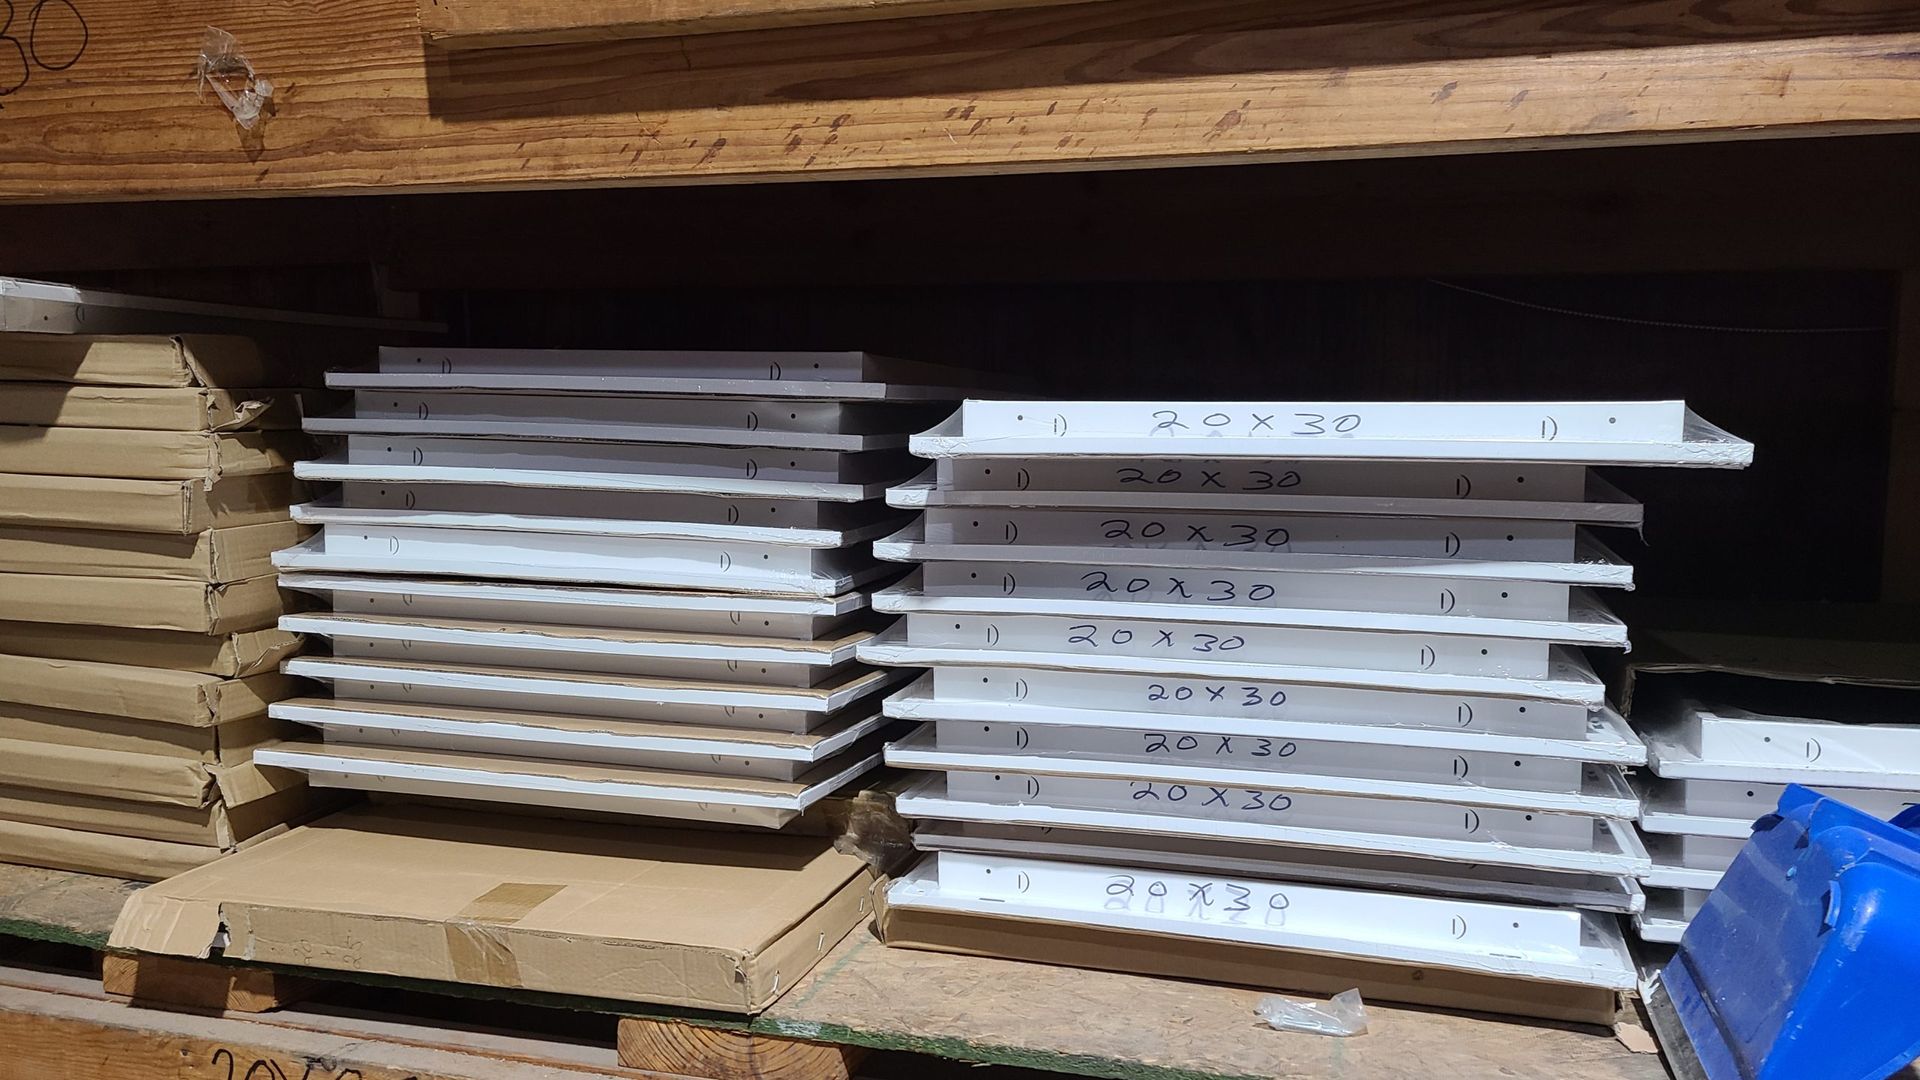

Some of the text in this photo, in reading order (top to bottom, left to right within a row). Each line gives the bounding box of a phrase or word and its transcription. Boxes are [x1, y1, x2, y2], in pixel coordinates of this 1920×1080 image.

[1152, 411, 1231, 430] 20
[1294, 413, 1362, 434] 30
[1117, 468, 1181, 484] 20
[1242, 470, 1302, 491] 30
[1101, 519, 1166, 539] 20
[1223, 524, 1290, 547] 30
[1081, 571, 1150, 593] 20
[1207, 580, 1276, 601] 30
[1068, 624, 1133, 648] 20
[1192, 634, 1245, 652] 30
[1148, 684, 1193, 701] 20
[1241, 686, 1287, 707] 30
[1144, 733, 1198, 754] 20
[1251, 738, 1298, 758] 30
[1130, 782, 1188, 801] 20
[1241, 789, 1293, 811] 30
[1106, 874, 1168, 897] 20
[1224, 883, 1290, 912] 30
